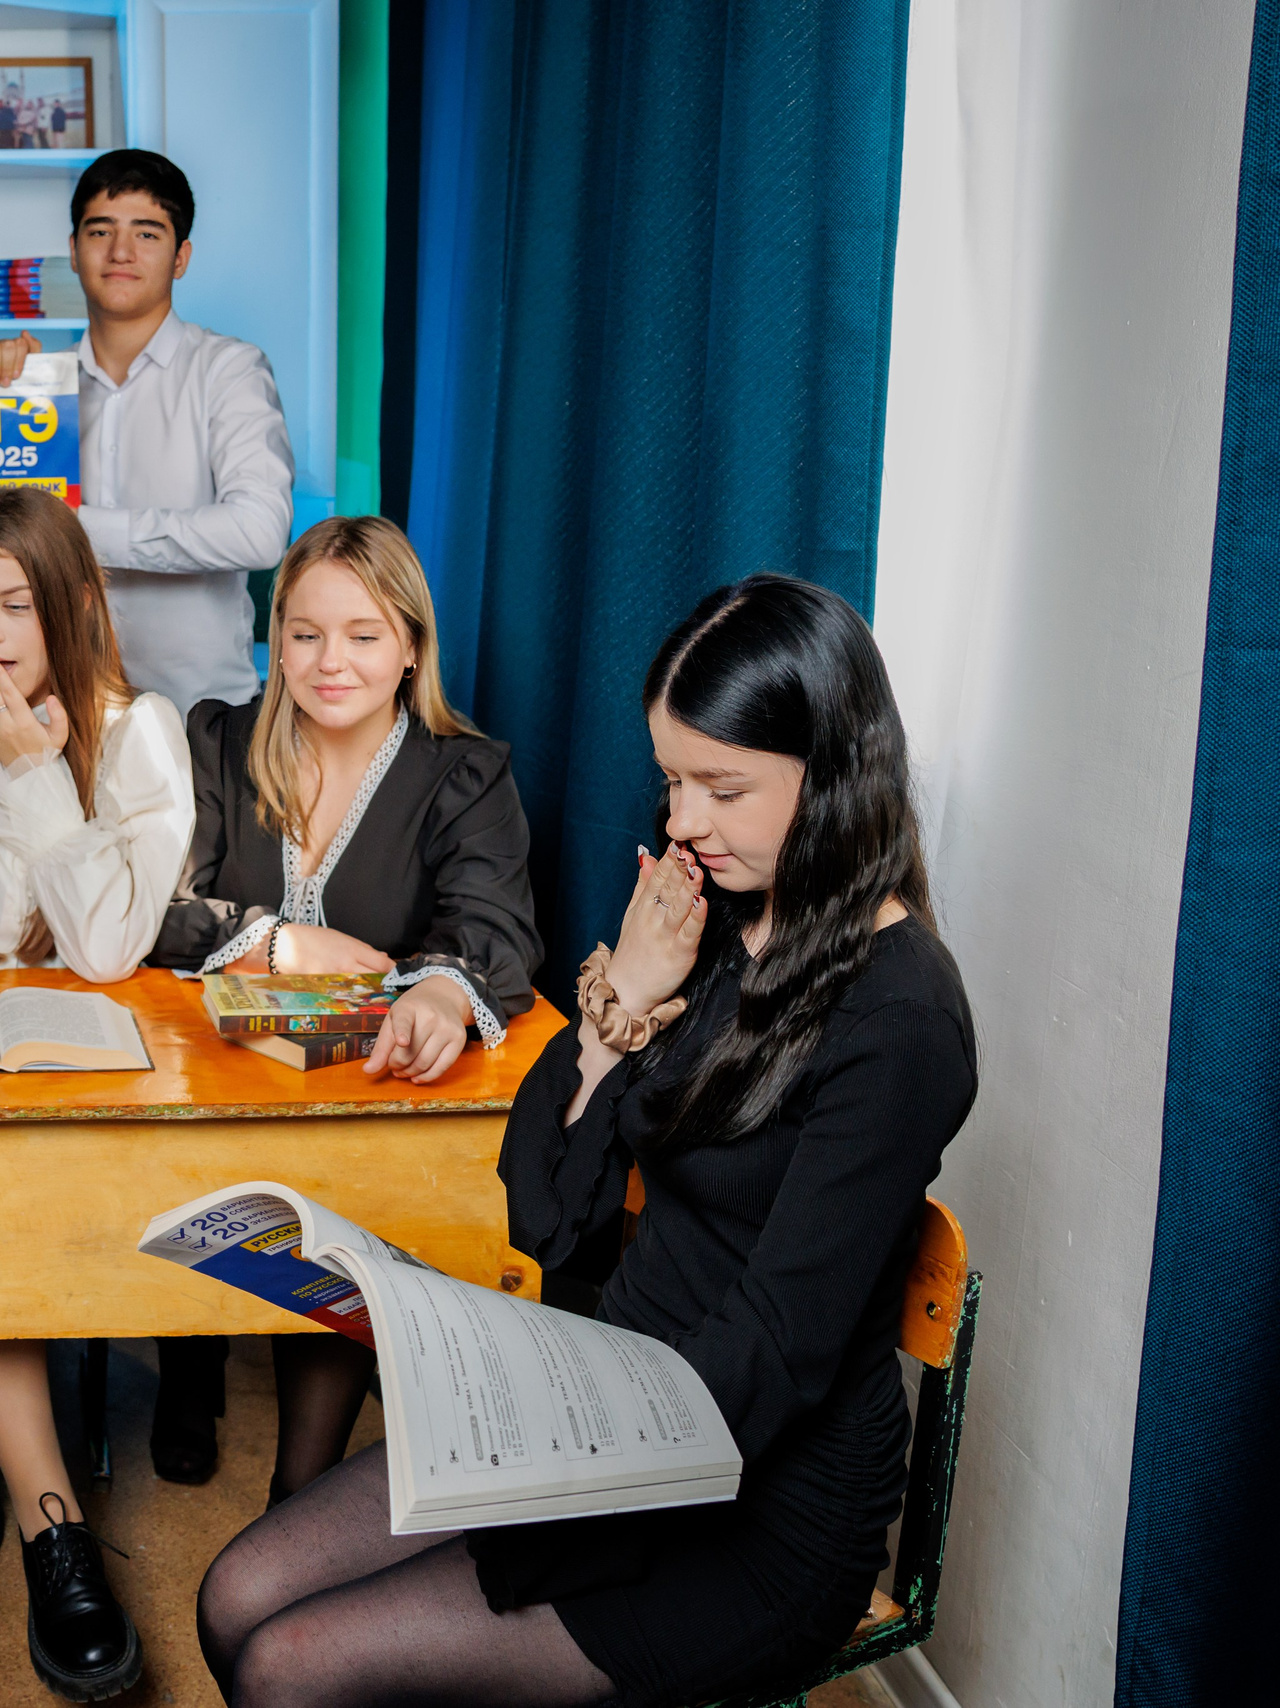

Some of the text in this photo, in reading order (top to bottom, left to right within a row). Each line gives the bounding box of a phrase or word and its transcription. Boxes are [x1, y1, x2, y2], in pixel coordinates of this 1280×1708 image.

[190, 1211, 228, 1231] 20
[212, 1221, 249, 1240] 20
[251, 1223, 302, 1247] РУССКИ
[291, 1273, 337, 1296] КОМПЛЕКС
[312, 1277, 344, 1293] РУССКО
